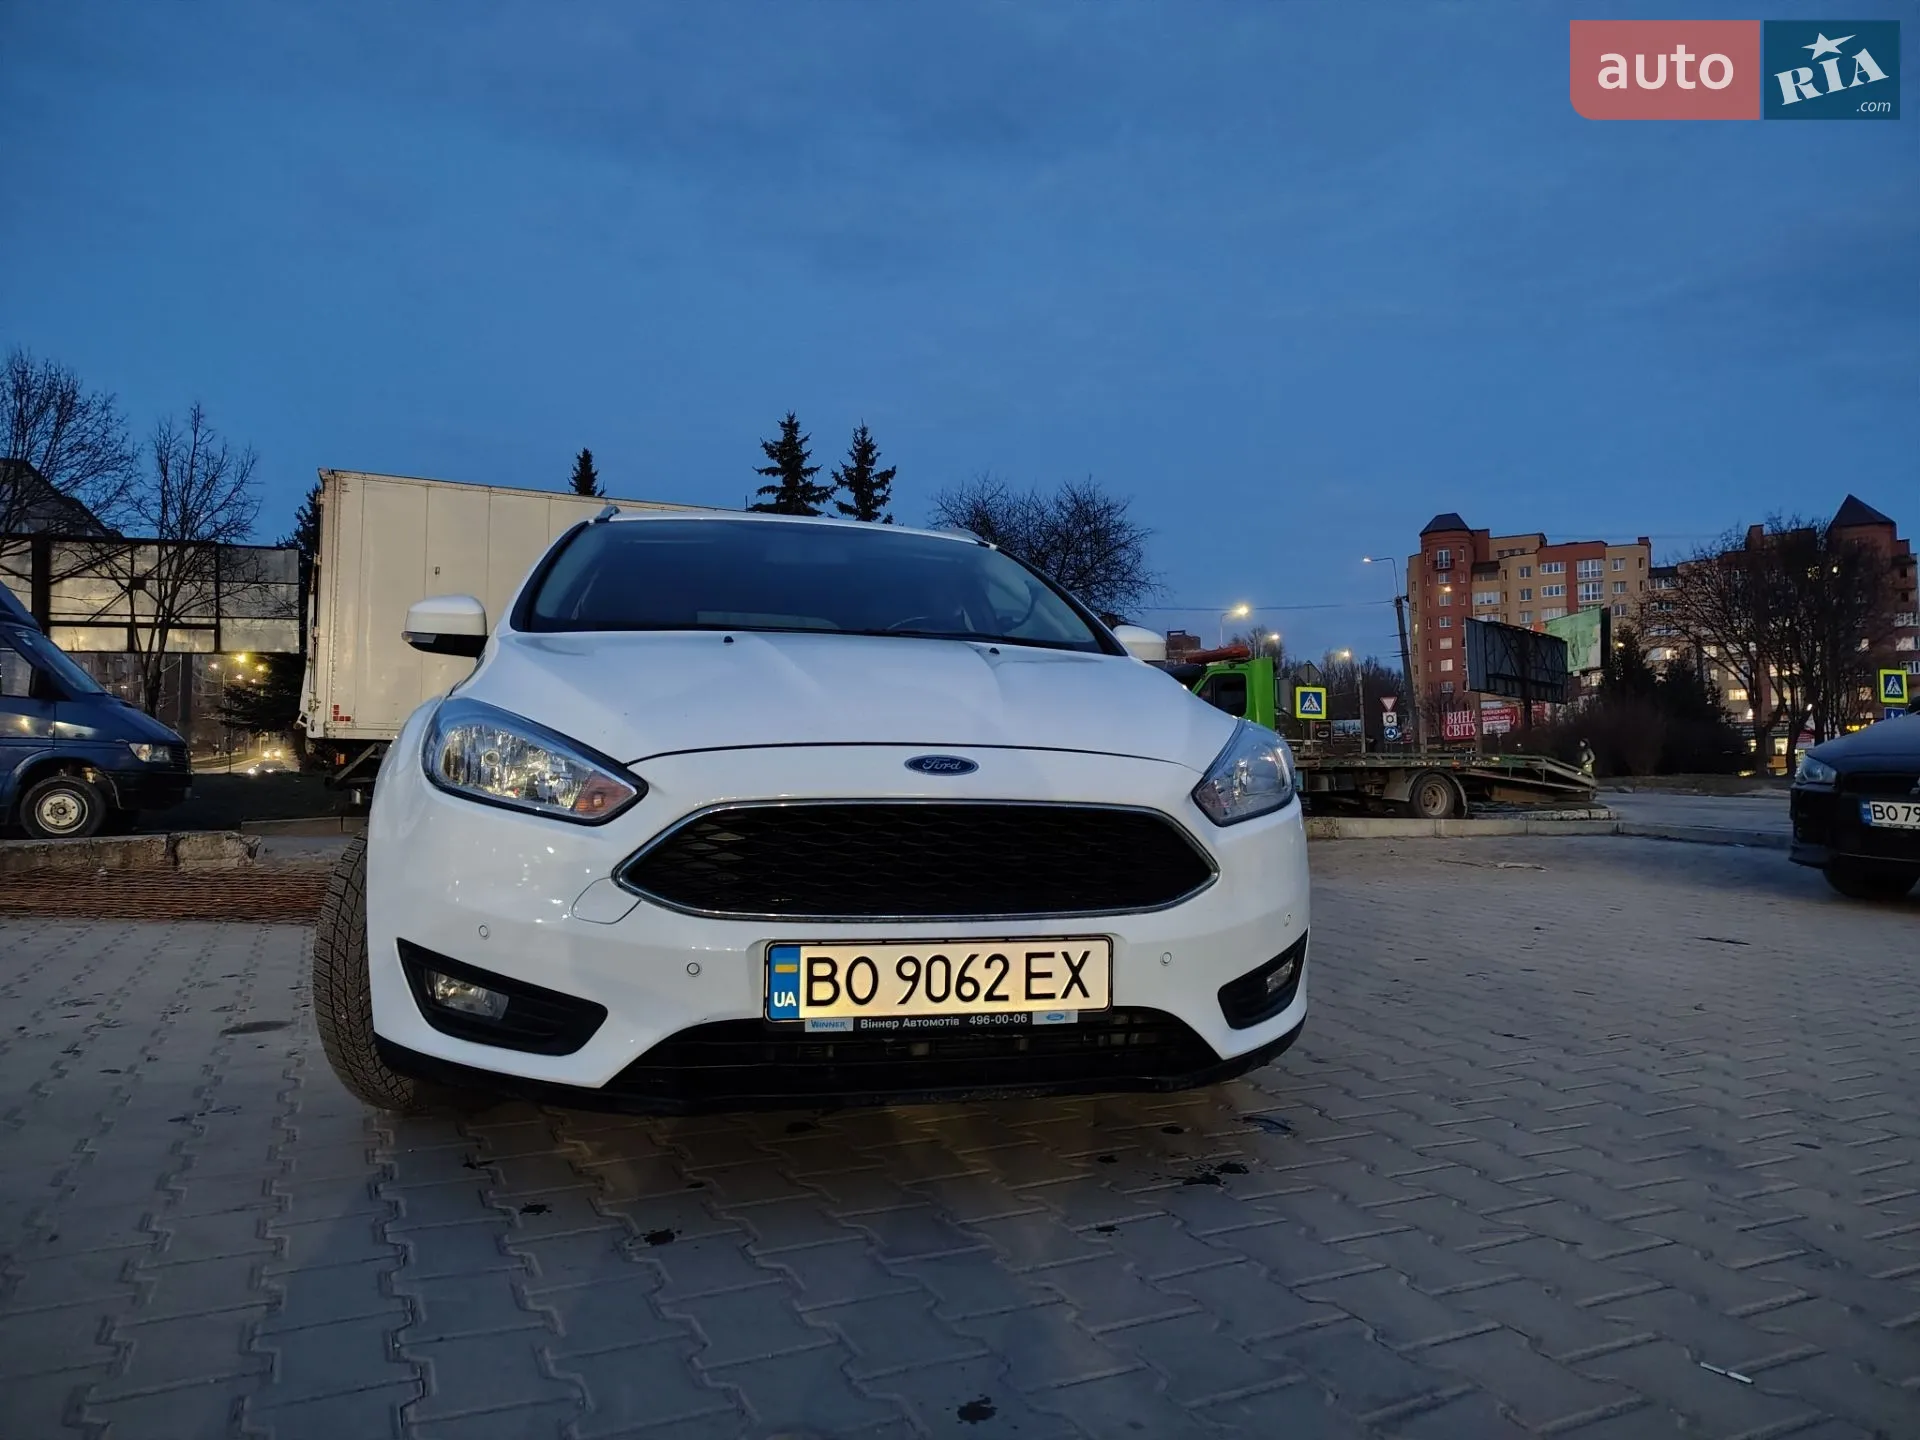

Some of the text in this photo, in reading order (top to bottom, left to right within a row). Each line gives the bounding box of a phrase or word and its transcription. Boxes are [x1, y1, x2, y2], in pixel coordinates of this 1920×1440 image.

[922, 758, 961, 770] Ford
[805, 950, 1091, 1007] BO 9062 EX
[773, 991, 797, 1008] UA
[860, 1013, 1028, 1030] Віннер Автомотів 496-00-06
